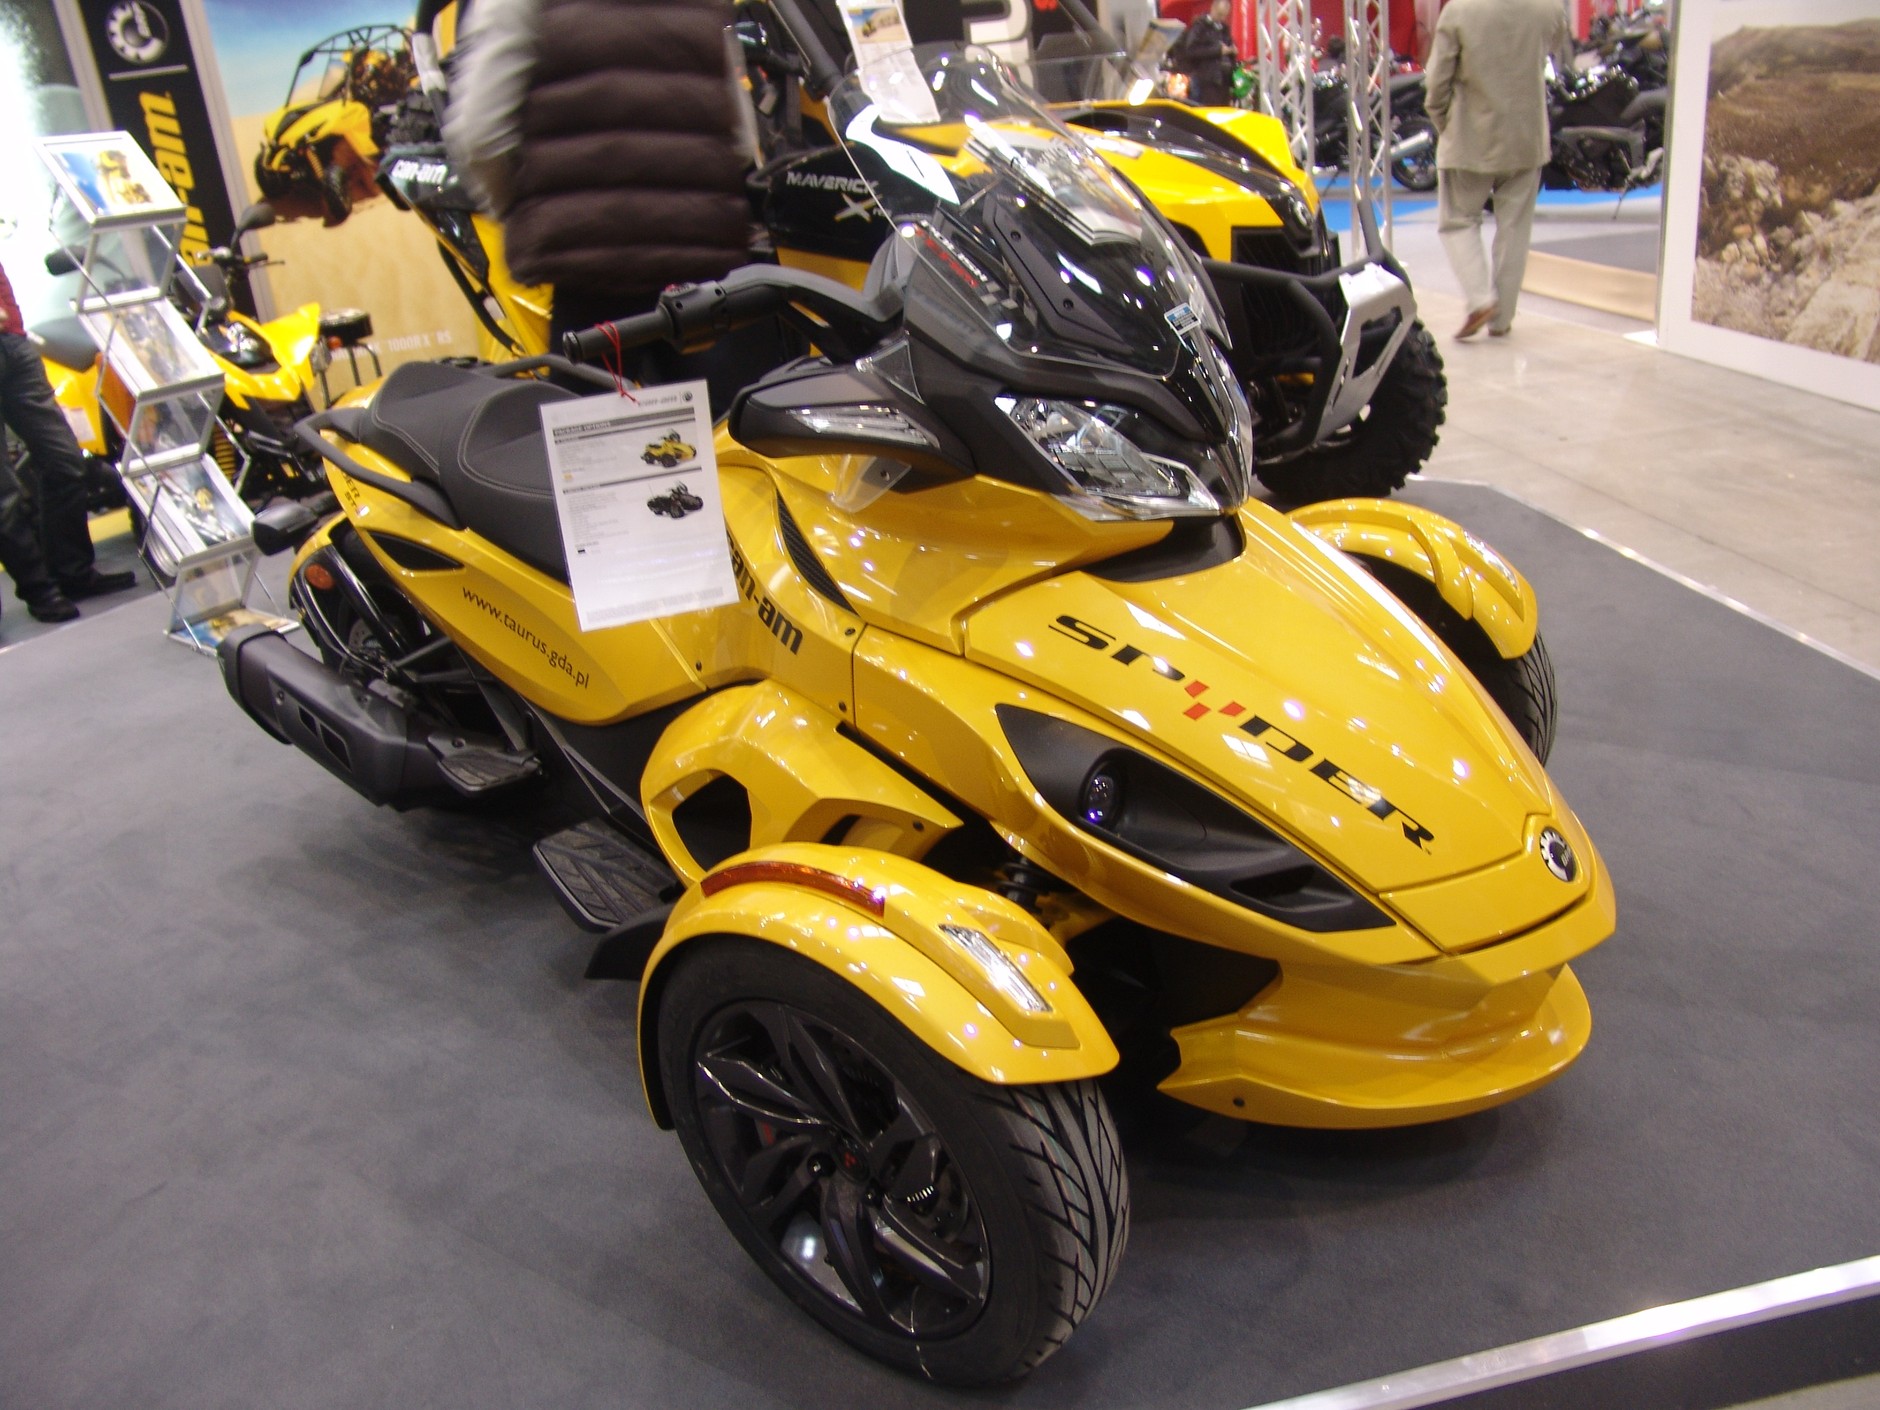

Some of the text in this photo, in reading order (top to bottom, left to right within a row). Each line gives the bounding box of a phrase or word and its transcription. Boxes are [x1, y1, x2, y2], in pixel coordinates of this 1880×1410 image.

[786, 170, 879, 195] MAVERICK
[463, 586, 590, 689] www.taurus.gda.pl
[1048, 615, 1435, 851] SPYDER
